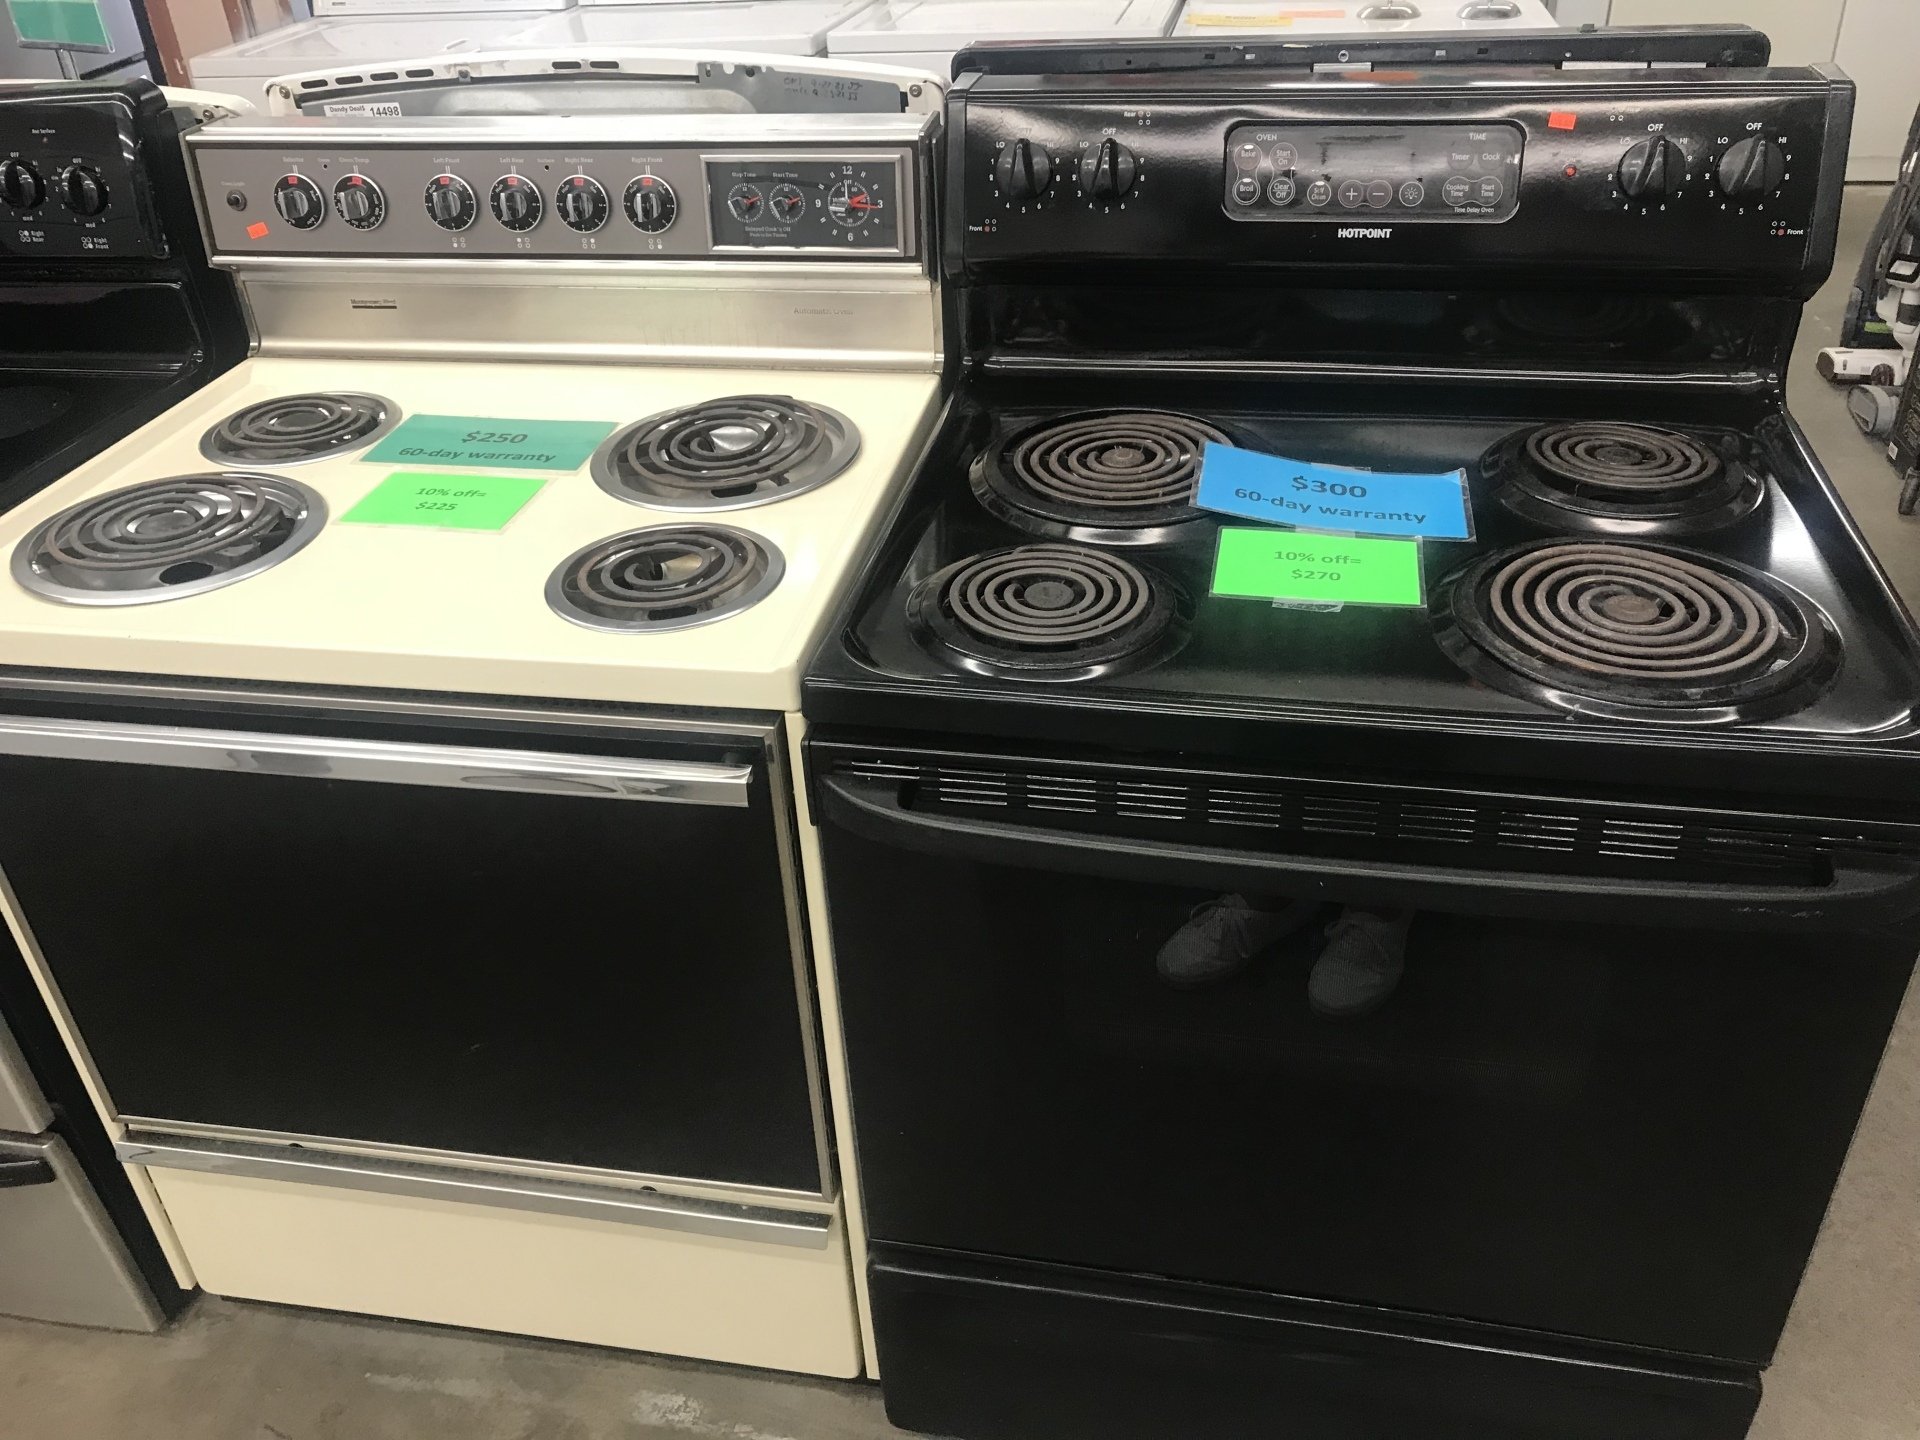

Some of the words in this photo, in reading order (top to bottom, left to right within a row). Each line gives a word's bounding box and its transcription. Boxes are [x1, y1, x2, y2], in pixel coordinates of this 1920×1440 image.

[369, 105, 400, 117] 14498
[1648, 123, 1664, 131] OFF
[1745, 122, 1762, 131] OFF
[995, 141, 1006, 149] LO
[1079, 141, 1089, 149] LO
[1717, 136, 1729, 144] LO
[1778, 136, 1787, 144] HI
[842, 165, 853, 174] 12
[1240, 184, 1254, 192] Broil
[1275, 191, 1287, 199] Off
[815, 198, 822, 208] 9
[1337, 228, 1392, 239] HOTPOINT
[461, 430, 528, 445] $250
[398, 447, 465, 461] 60-day
[467, 450, 557, 463] warranty
[1291, 475, 1368, 499] $300
[415, 486, 451, 498] 10%
[453, 488, 488, 499] off=
[414, 500, 459, 512] $225
[1234, 487, 1312, 514] 60-day
[1318, 505, 1428, 525] warranty
[1273, 550, 1316, 564] 10%
[1321, 553, 1362, 565] off=
[1291, 569, 1341, 582] $270
